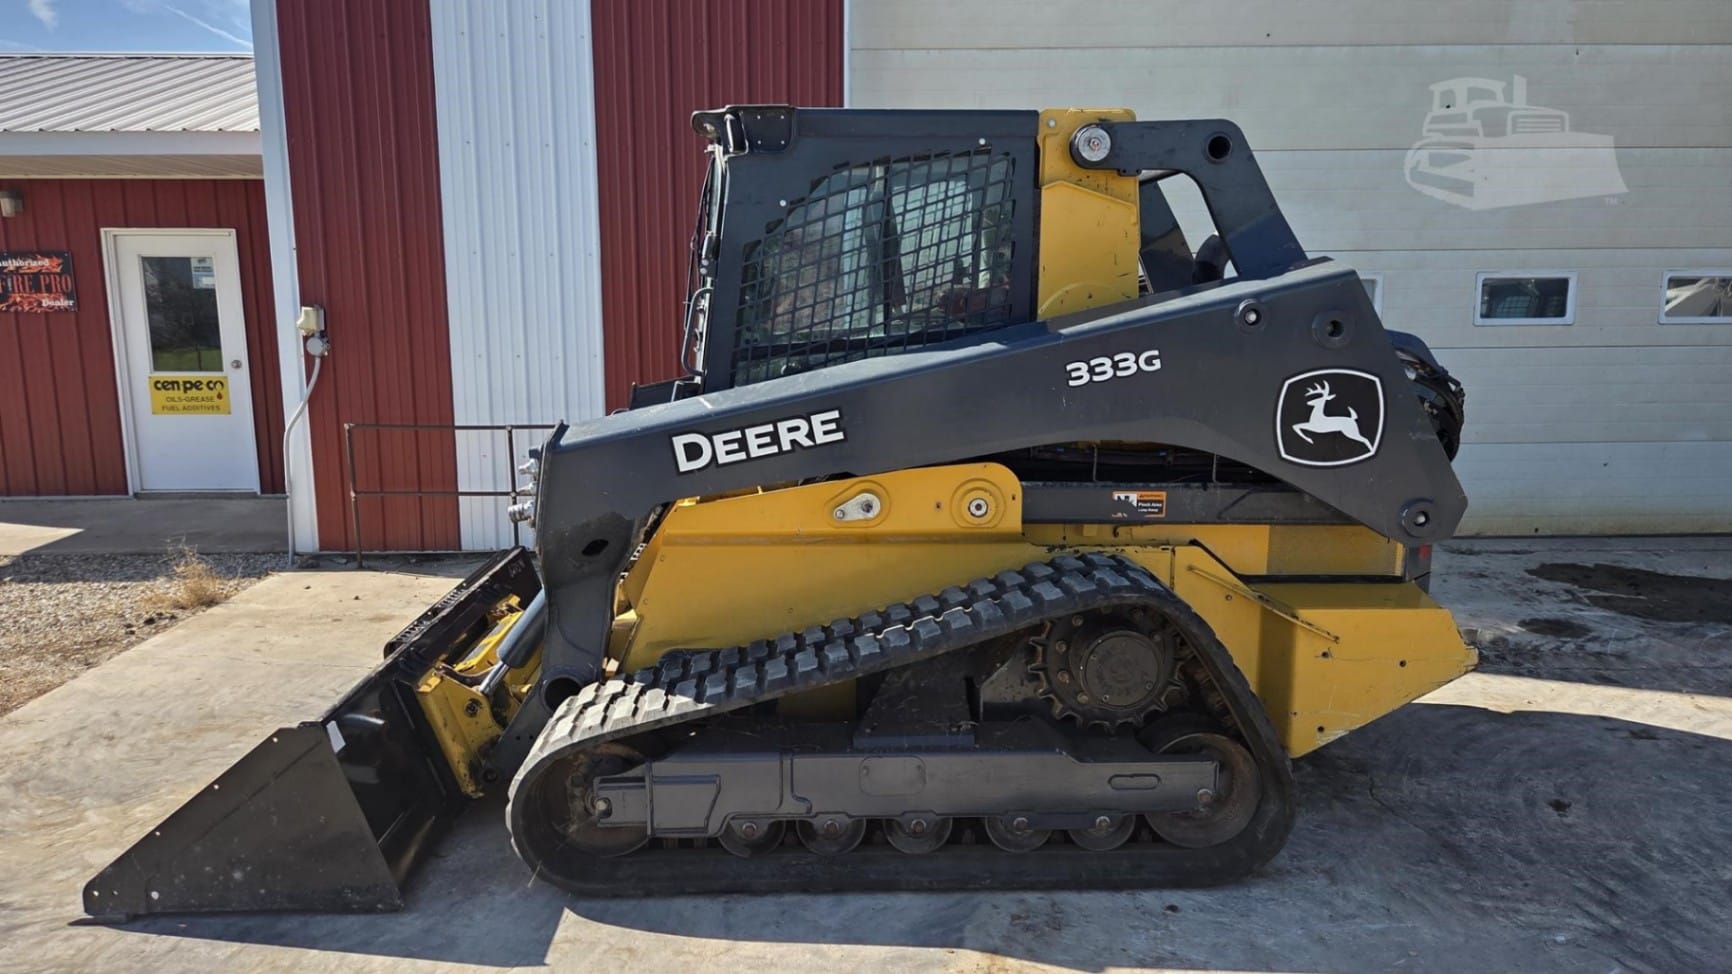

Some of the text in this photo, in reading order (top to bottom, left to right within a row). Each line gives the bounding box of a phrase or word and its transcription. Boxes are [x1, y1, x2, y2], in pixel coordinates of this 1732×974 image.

[41, 273, 72, 293] PRO
[41, 299, 74, 307] Dealer
[1066, 350, 1161, 386] 333G
[672, 410, 845, 472] DEERE
